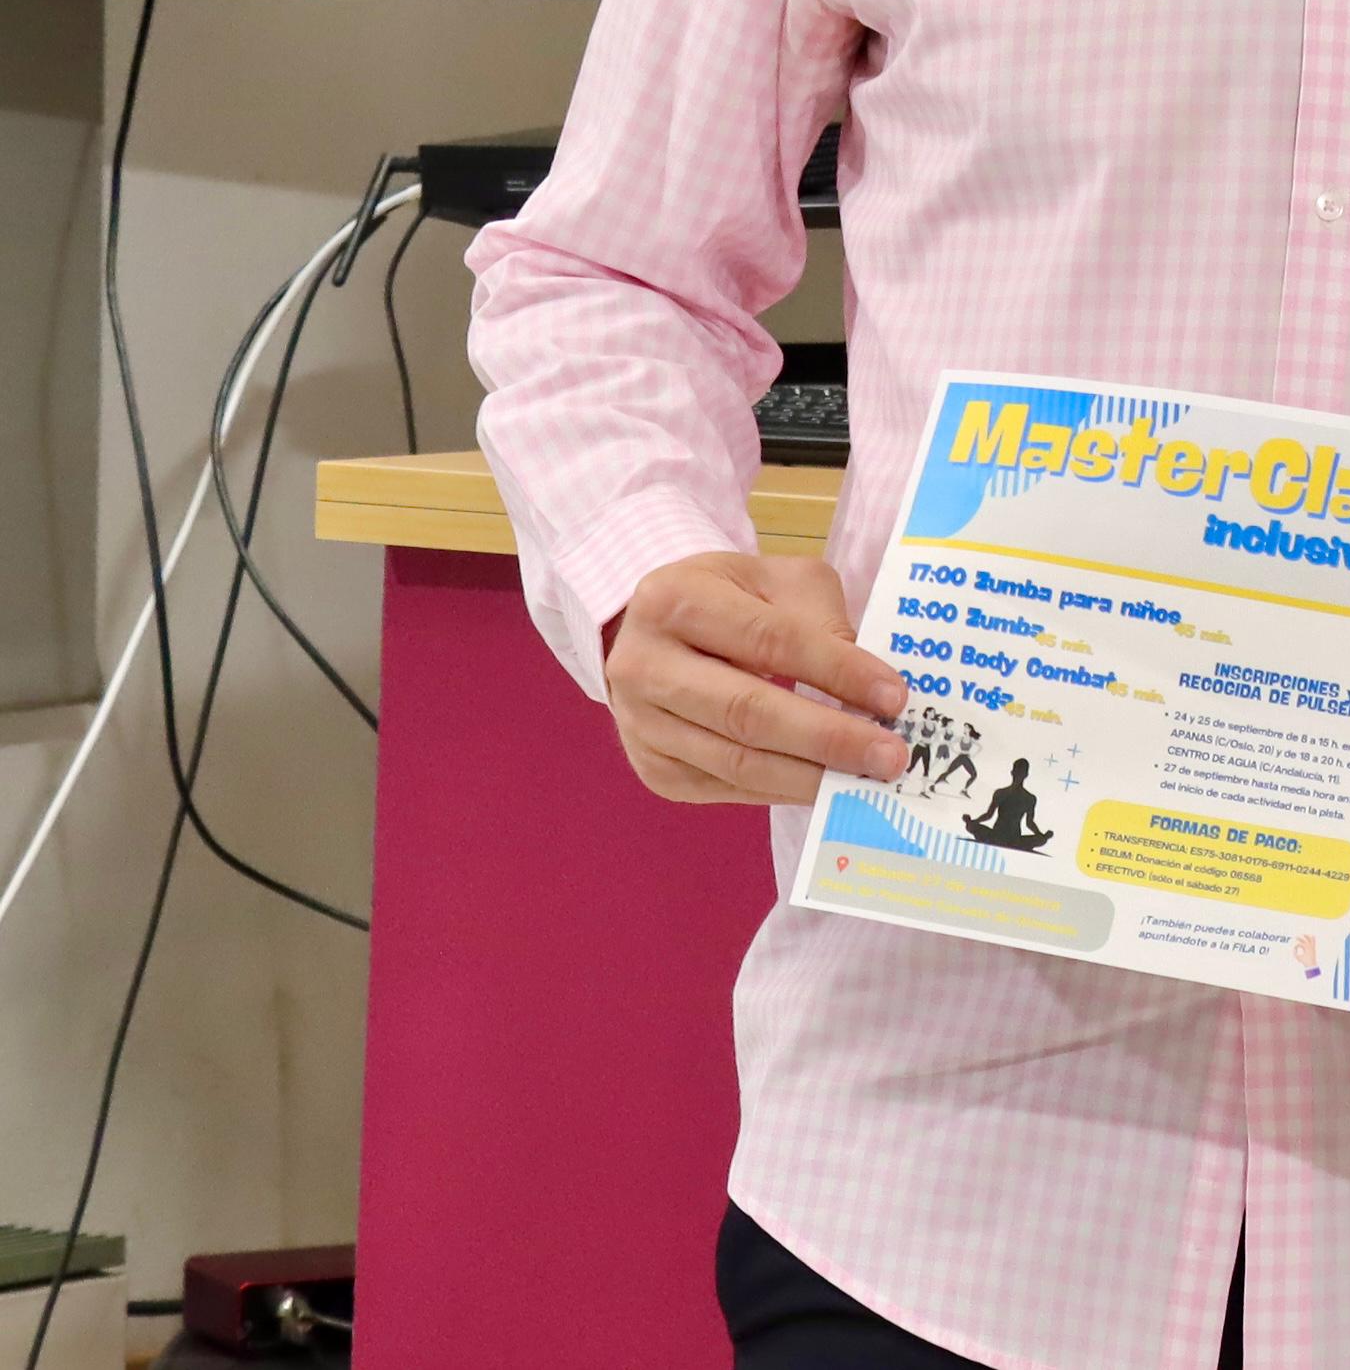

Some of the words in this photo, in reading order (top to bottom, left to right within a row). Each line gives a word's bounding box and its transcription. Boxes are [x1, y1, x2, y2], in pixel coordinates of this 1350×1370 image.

[909, 563, 967, 587] 17:00
[974, 570, 1053, 603] Zumba
[1058, 590, 1113, 614] para
[1120, 600, 1182, 628] niños
[897, 597, 958, 623] 18:00
[965, 607, 1045, 641] Zumba
[890, 632, 953, 661] 19:00
[960, 645, 1019, 678] Body
[1026, 657, 1117, 692] Combat
[1214, 662, 1340, 692] INSCRIPCIONES
[899, 670, 951, 697] 0:00
[960, 680, 1014, 711] Yoga
[1268, 689, 1291, 706] DE
[1104, 831, 1188, 854] TRANSFERENCIA:
[1150, 815, 1221, 839] FORMAS
[1226, 828, 1249, 844] DE
[1099, 847, 1133, 860] BIZUM:
[1135, 853, 1182, 869] Donación
[1183, 862, 1193, 871] al
[1193, 865, 1228, 878] código
[1095, 862, 1147, 879] EFECTIVO:
[1148, 871, 1173, 884] (sólo
[1174, 878, 1185, 886] el
[1186, 881, 1223, 893] sábado
[1224, 886, 1240, 896] 27)
